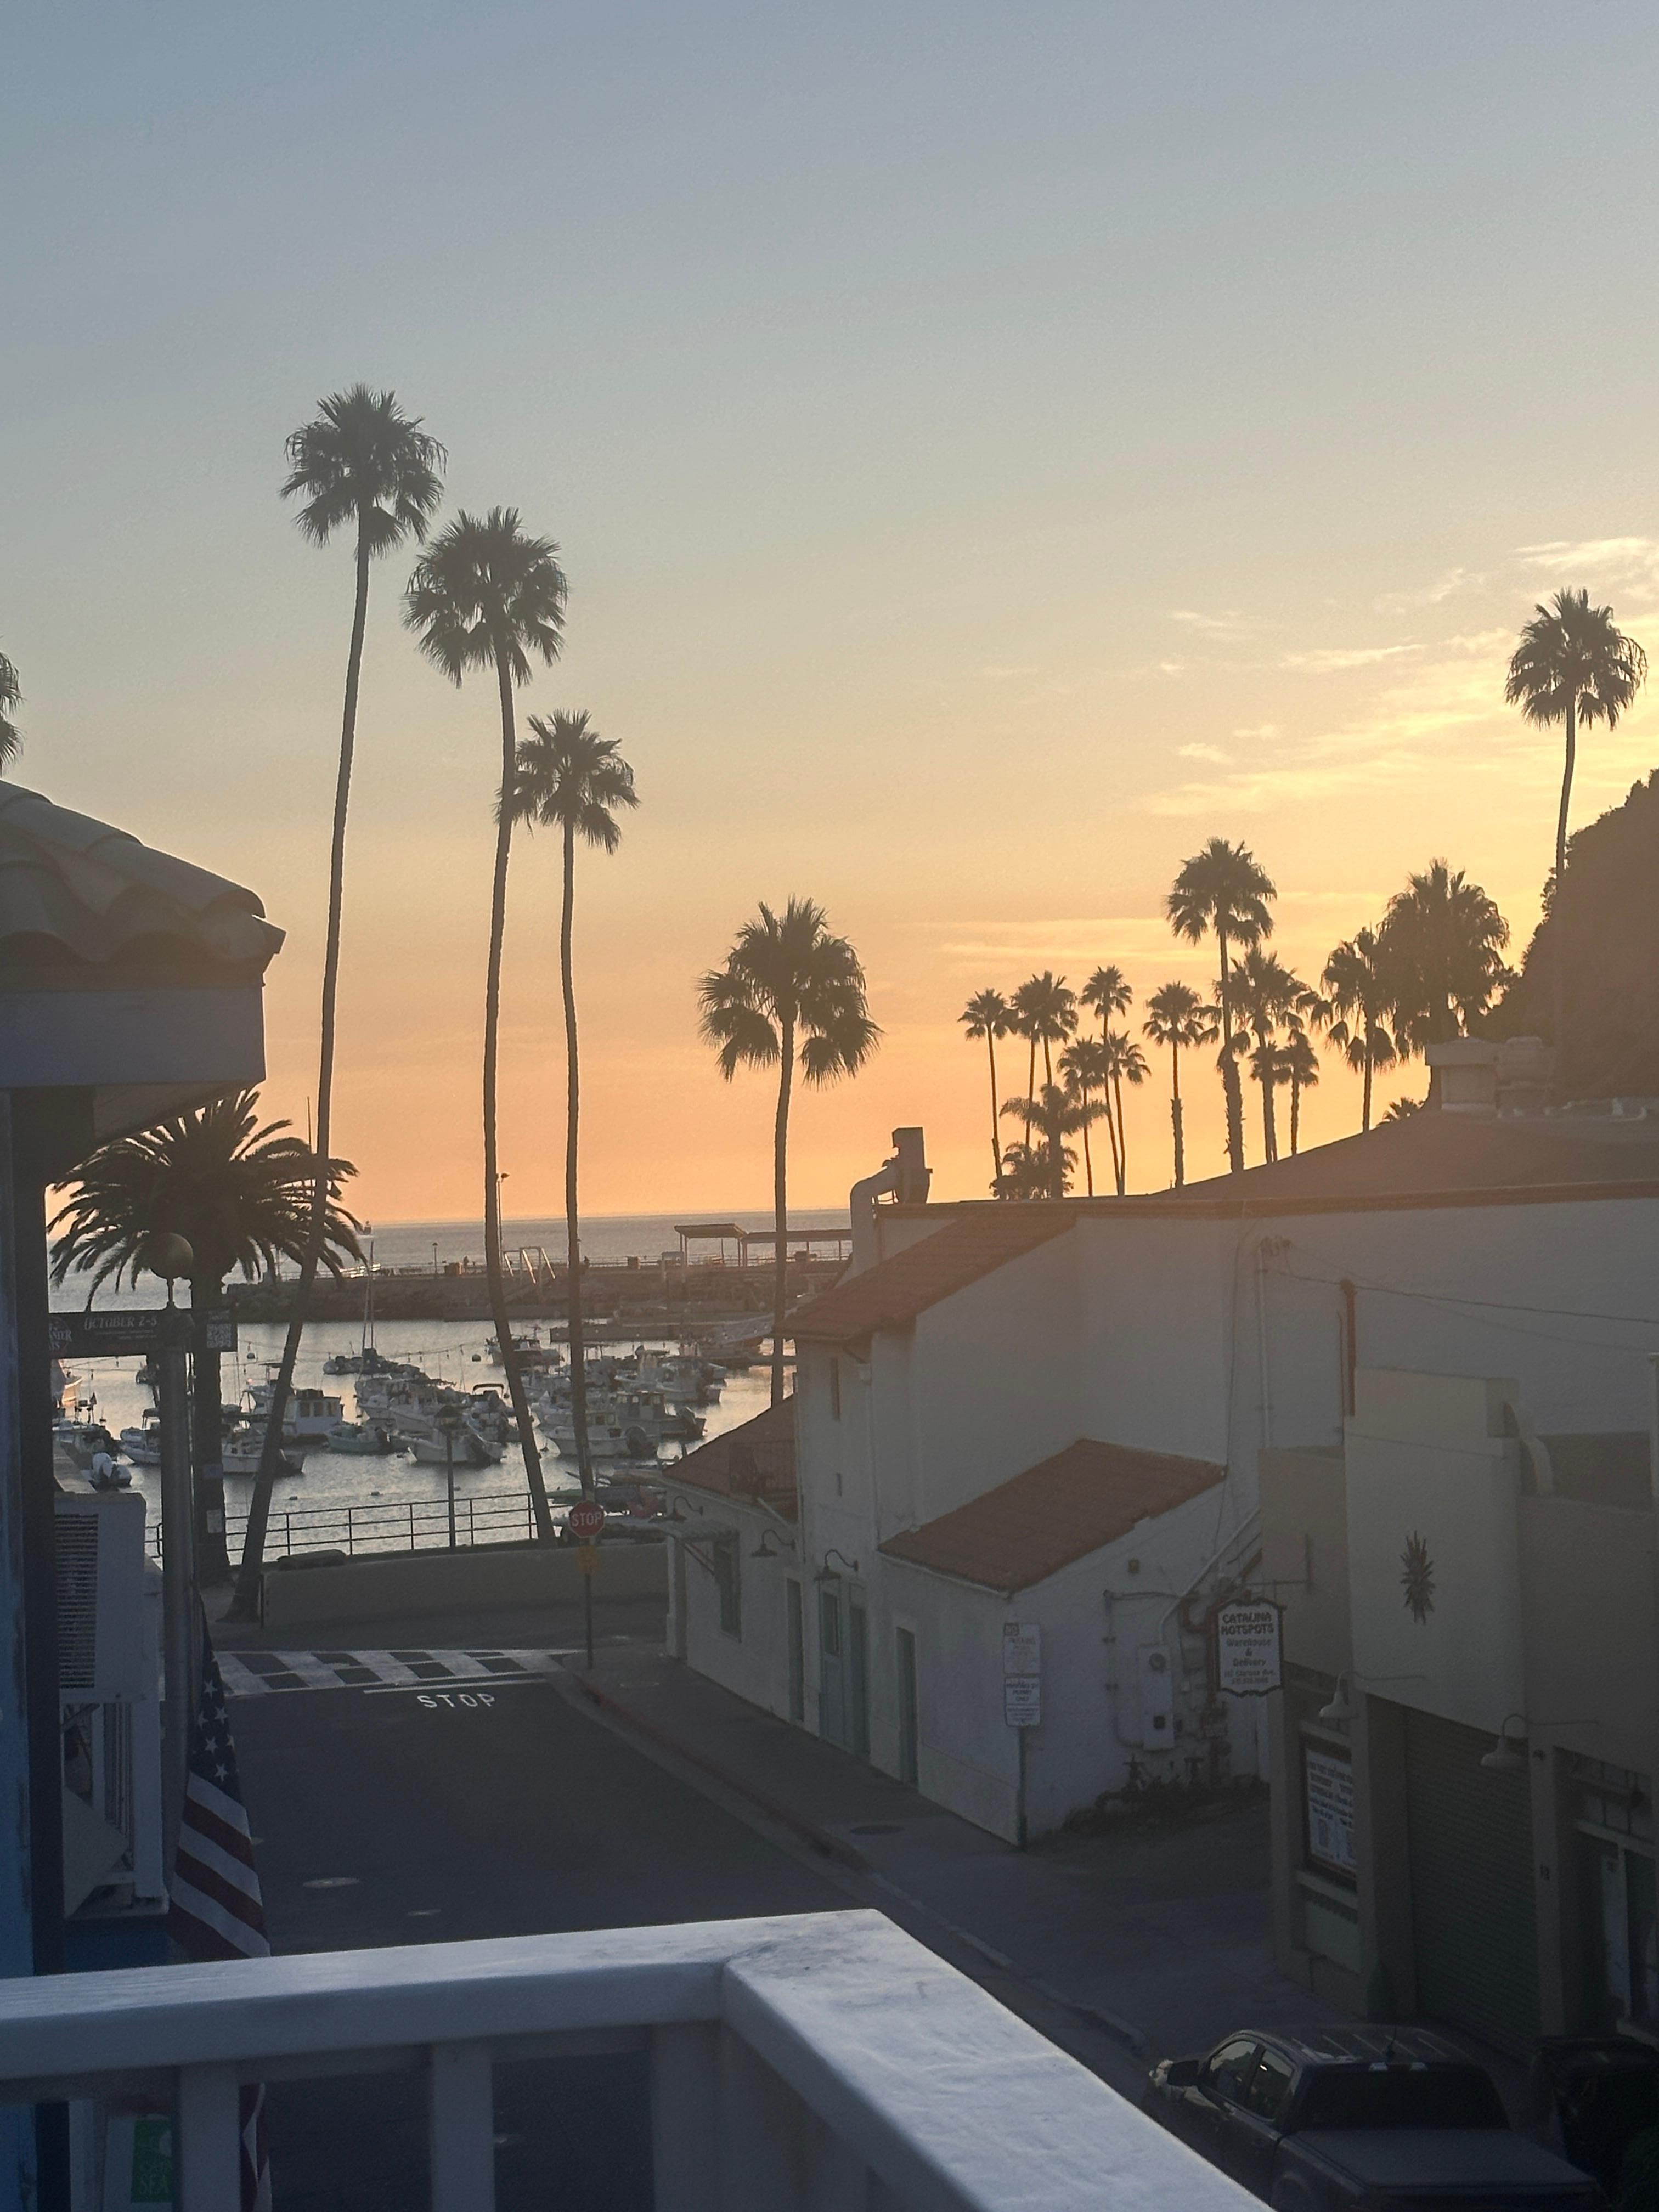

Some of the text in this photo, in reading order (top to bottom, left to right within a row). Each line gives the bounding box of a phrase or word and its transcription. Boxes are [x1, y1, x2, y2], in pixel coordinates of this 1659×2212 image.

[84, 1317, 157, 1330] OCTOBER 2-5
[571, 1511, 602, 1526] STOP
[1222, 1612, 1272, 1624] CATALINA
[1221, 1623, 1274, 1635] HOTSPOTS
[1245, 1647, 1252, 1657] &
[1232, 1657, 1267, 1667] Delivery
[417, 1693, 495, 1708] STOP
